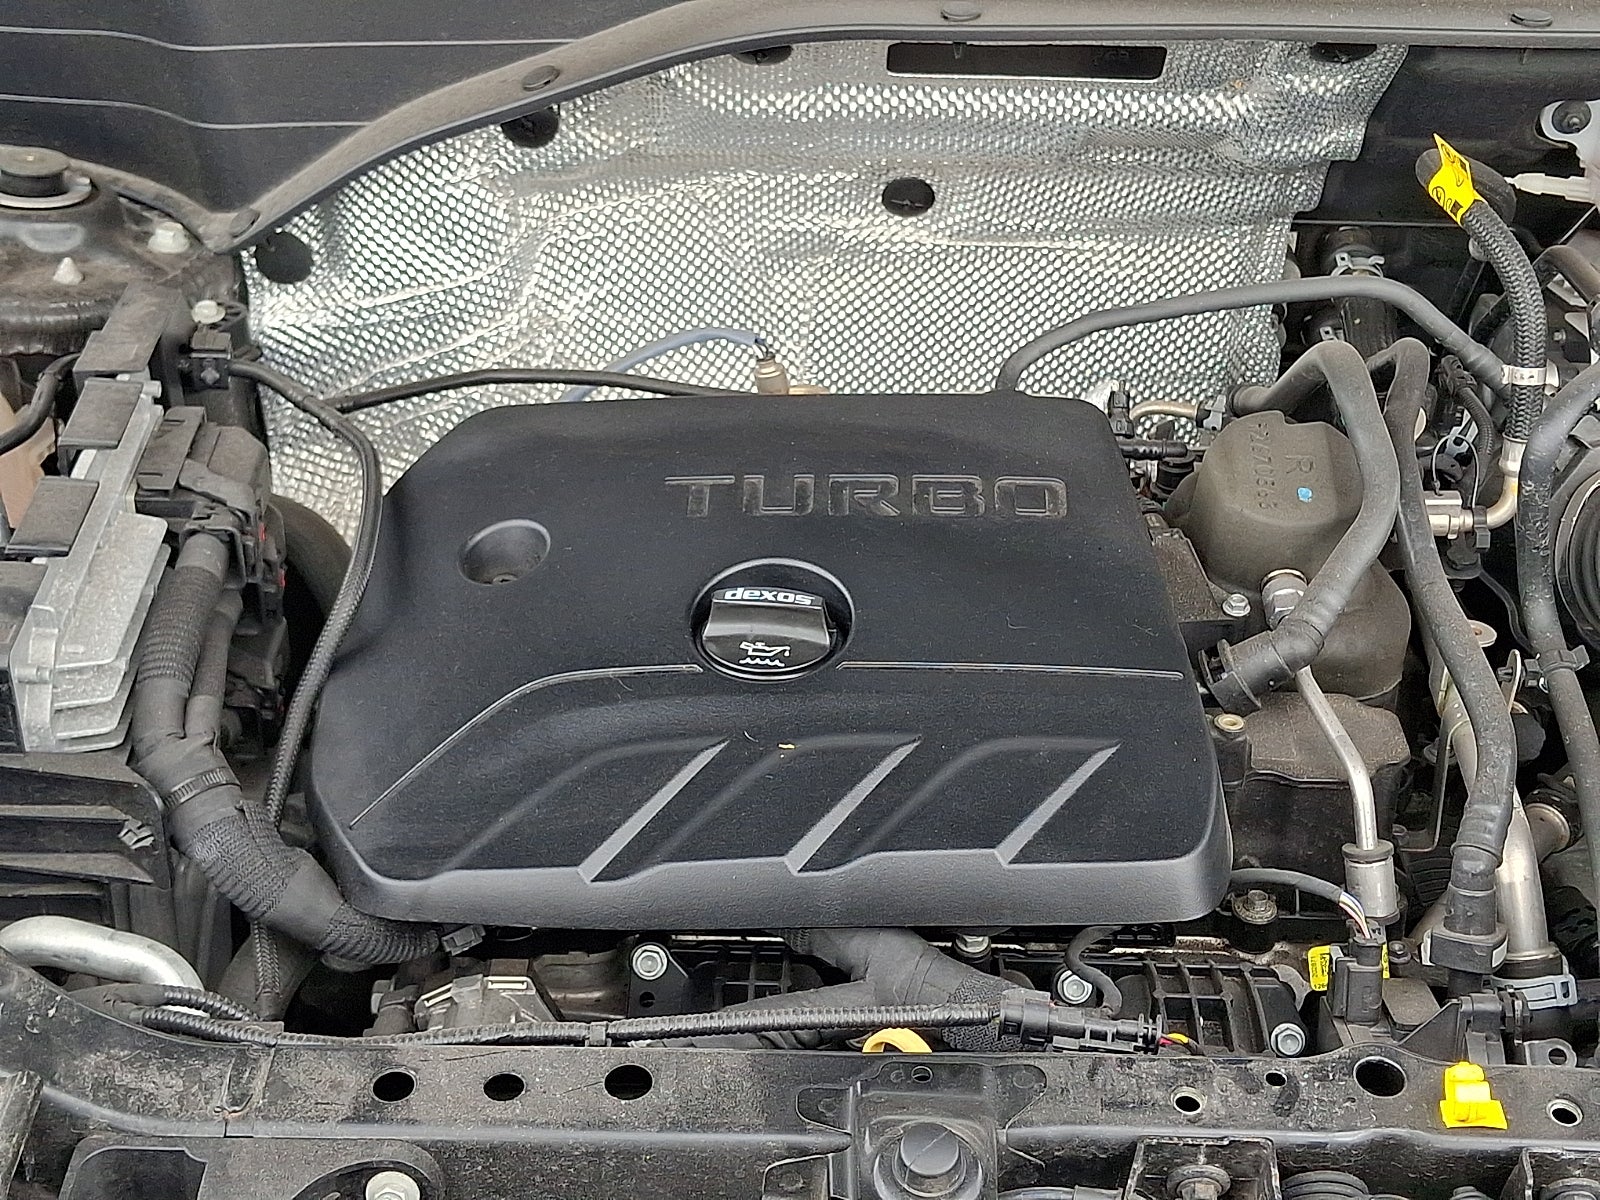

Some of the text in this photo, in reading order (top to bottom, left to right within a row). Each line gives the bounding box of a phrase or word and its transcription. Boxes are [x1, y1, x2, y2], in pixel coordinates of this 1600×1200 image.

[1284, 454, 1315, 474] R
[664, 474, 1069, 518] TURBO
[724, 587, 816, 606] dexos
